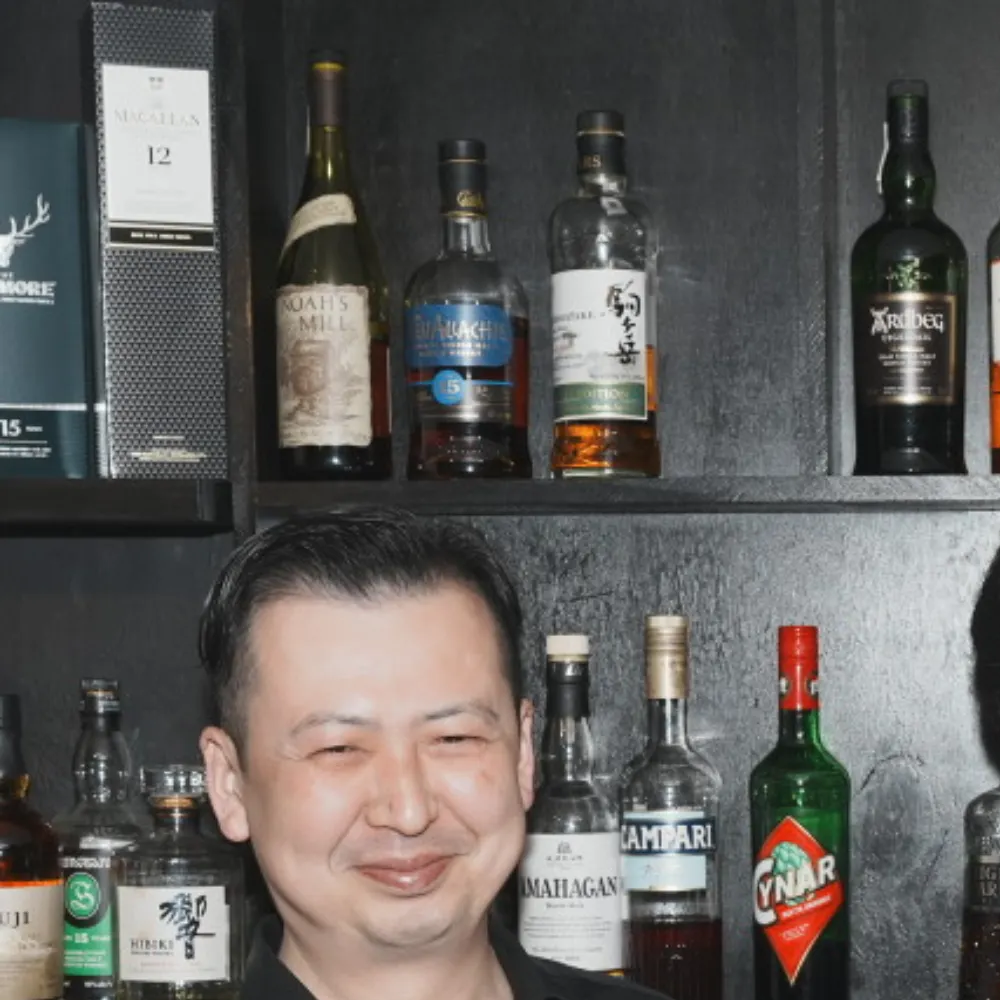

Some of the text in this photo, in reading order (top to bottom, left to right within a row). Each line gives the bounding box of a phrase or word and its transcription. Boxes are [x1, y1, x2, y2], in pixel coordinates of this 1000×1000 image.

[147, 144, 172, 165] 12
[0, 418, 22, 437] 15
[752, 854, 836, 925] CYNAR
[129, 938, 174, 951] HIBIKI
